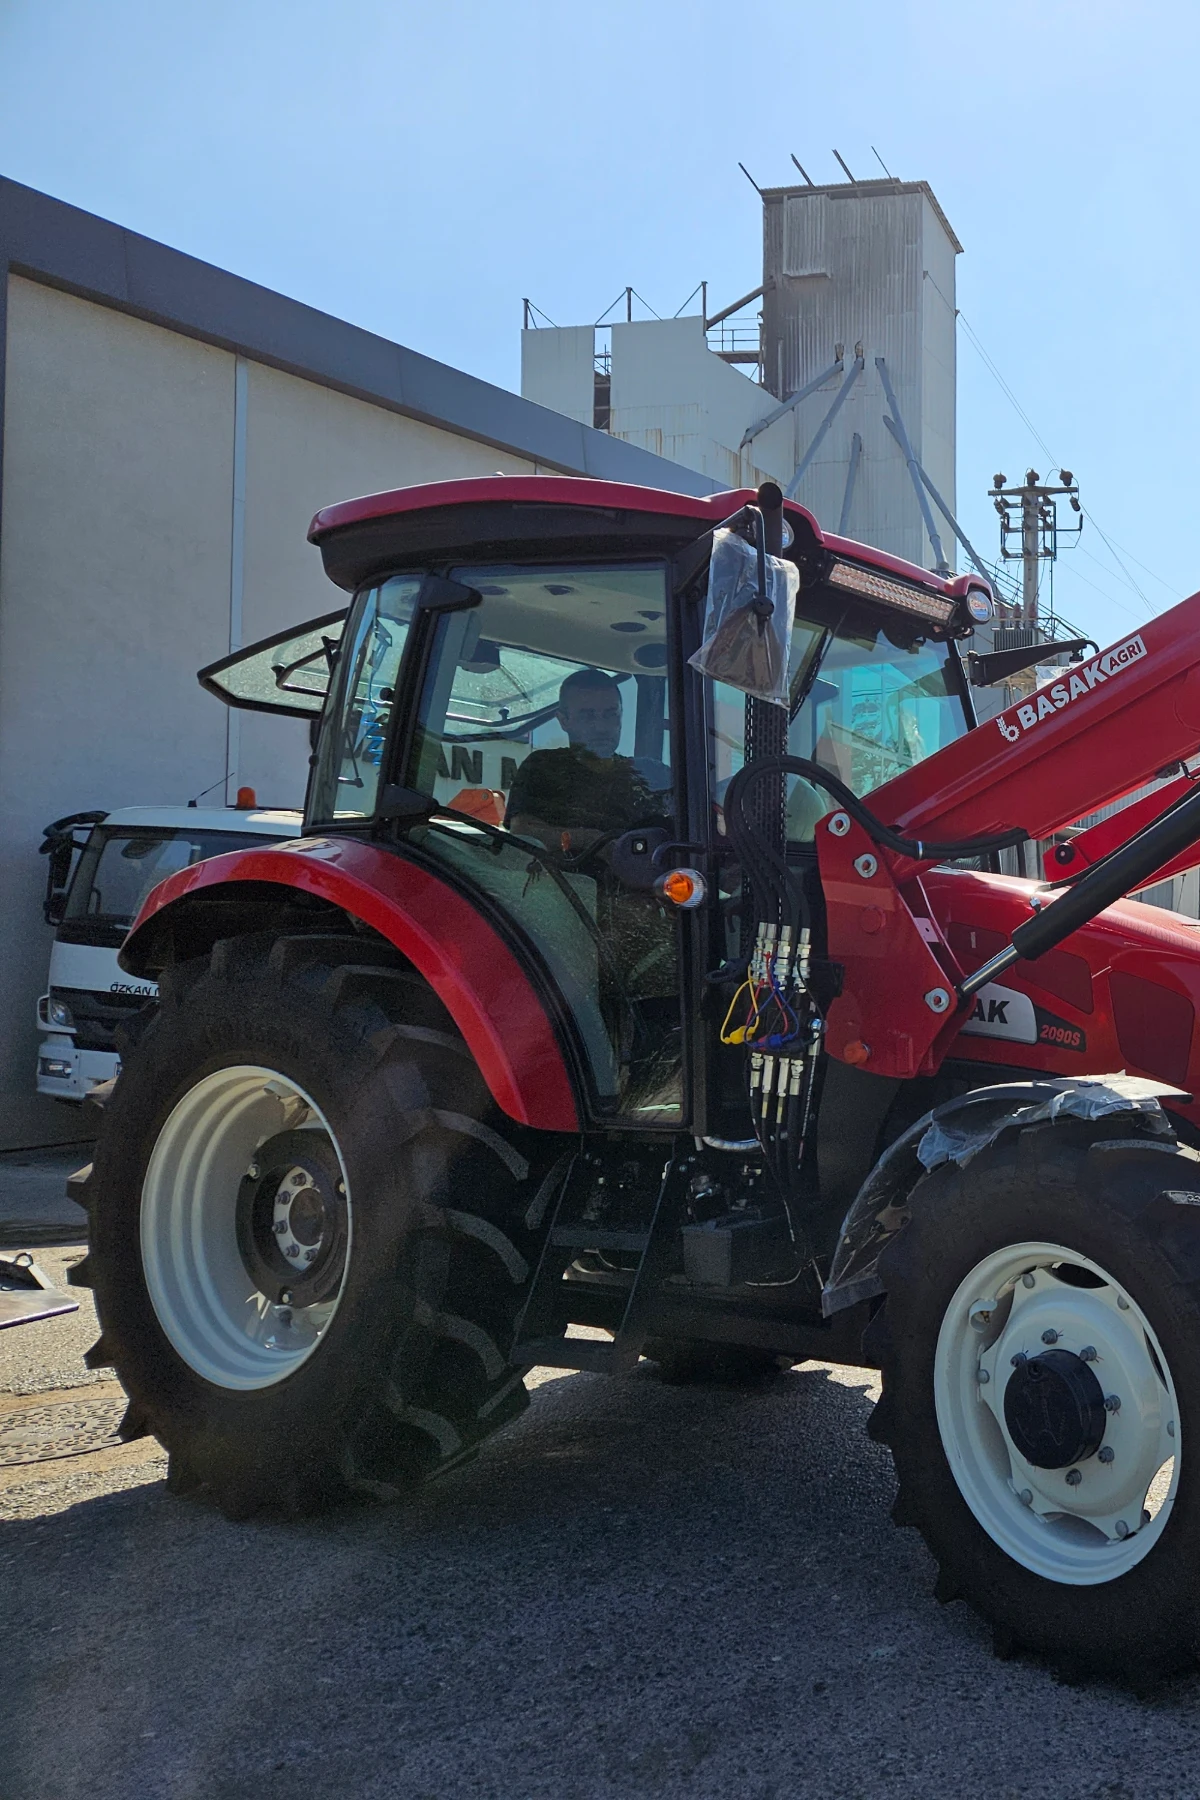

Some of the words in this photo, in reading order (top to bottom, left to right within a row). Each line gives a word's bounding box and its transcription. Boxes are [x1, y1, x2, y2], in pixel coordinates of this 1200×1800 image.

[1109, 640, 1142, 672] AGRI
[110, 981, 152, 996] ÖZKAN
[1040, 1024, 1081, 1046] 2090S
